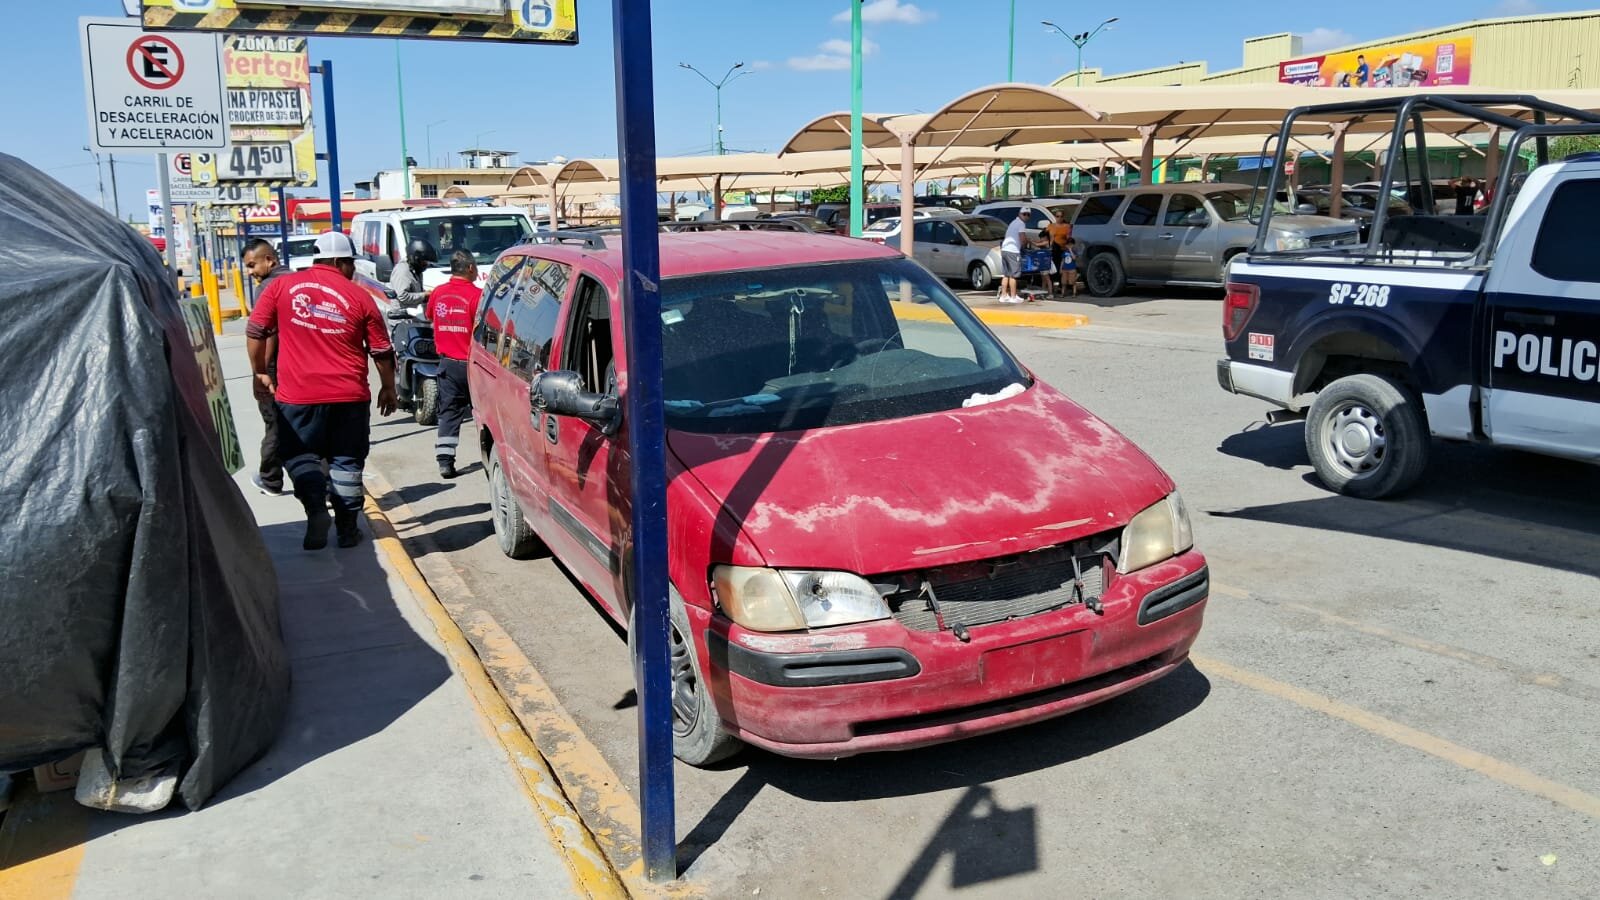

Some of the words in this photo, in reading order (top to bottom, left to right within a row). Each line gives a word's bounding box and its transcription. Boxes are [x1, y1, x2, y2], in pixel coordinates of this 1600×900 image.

[236, 36, 274, 51] ZONA
[278, 36, 297, 52] DE
[224, 49, 301, 79] ferta!
[124, 96, 172, 107] CARRIL
[176, 97, 193, 108] DE
[227, 91, 246, 108] INA
[99, 110, 220, 125] DESACELERACIÓN
[228, 110, 265, 122] CROCKER
[265, 111, 275, 120] DE
[108, 128, 117, 139] Y
[120, 126, 213, 140] ACELERACIÓN
[1329, 283, 1390, 307] SP-268
[1250, 334, 1273, 347] 911
[1494, 330, 1600, 382] POLIC
